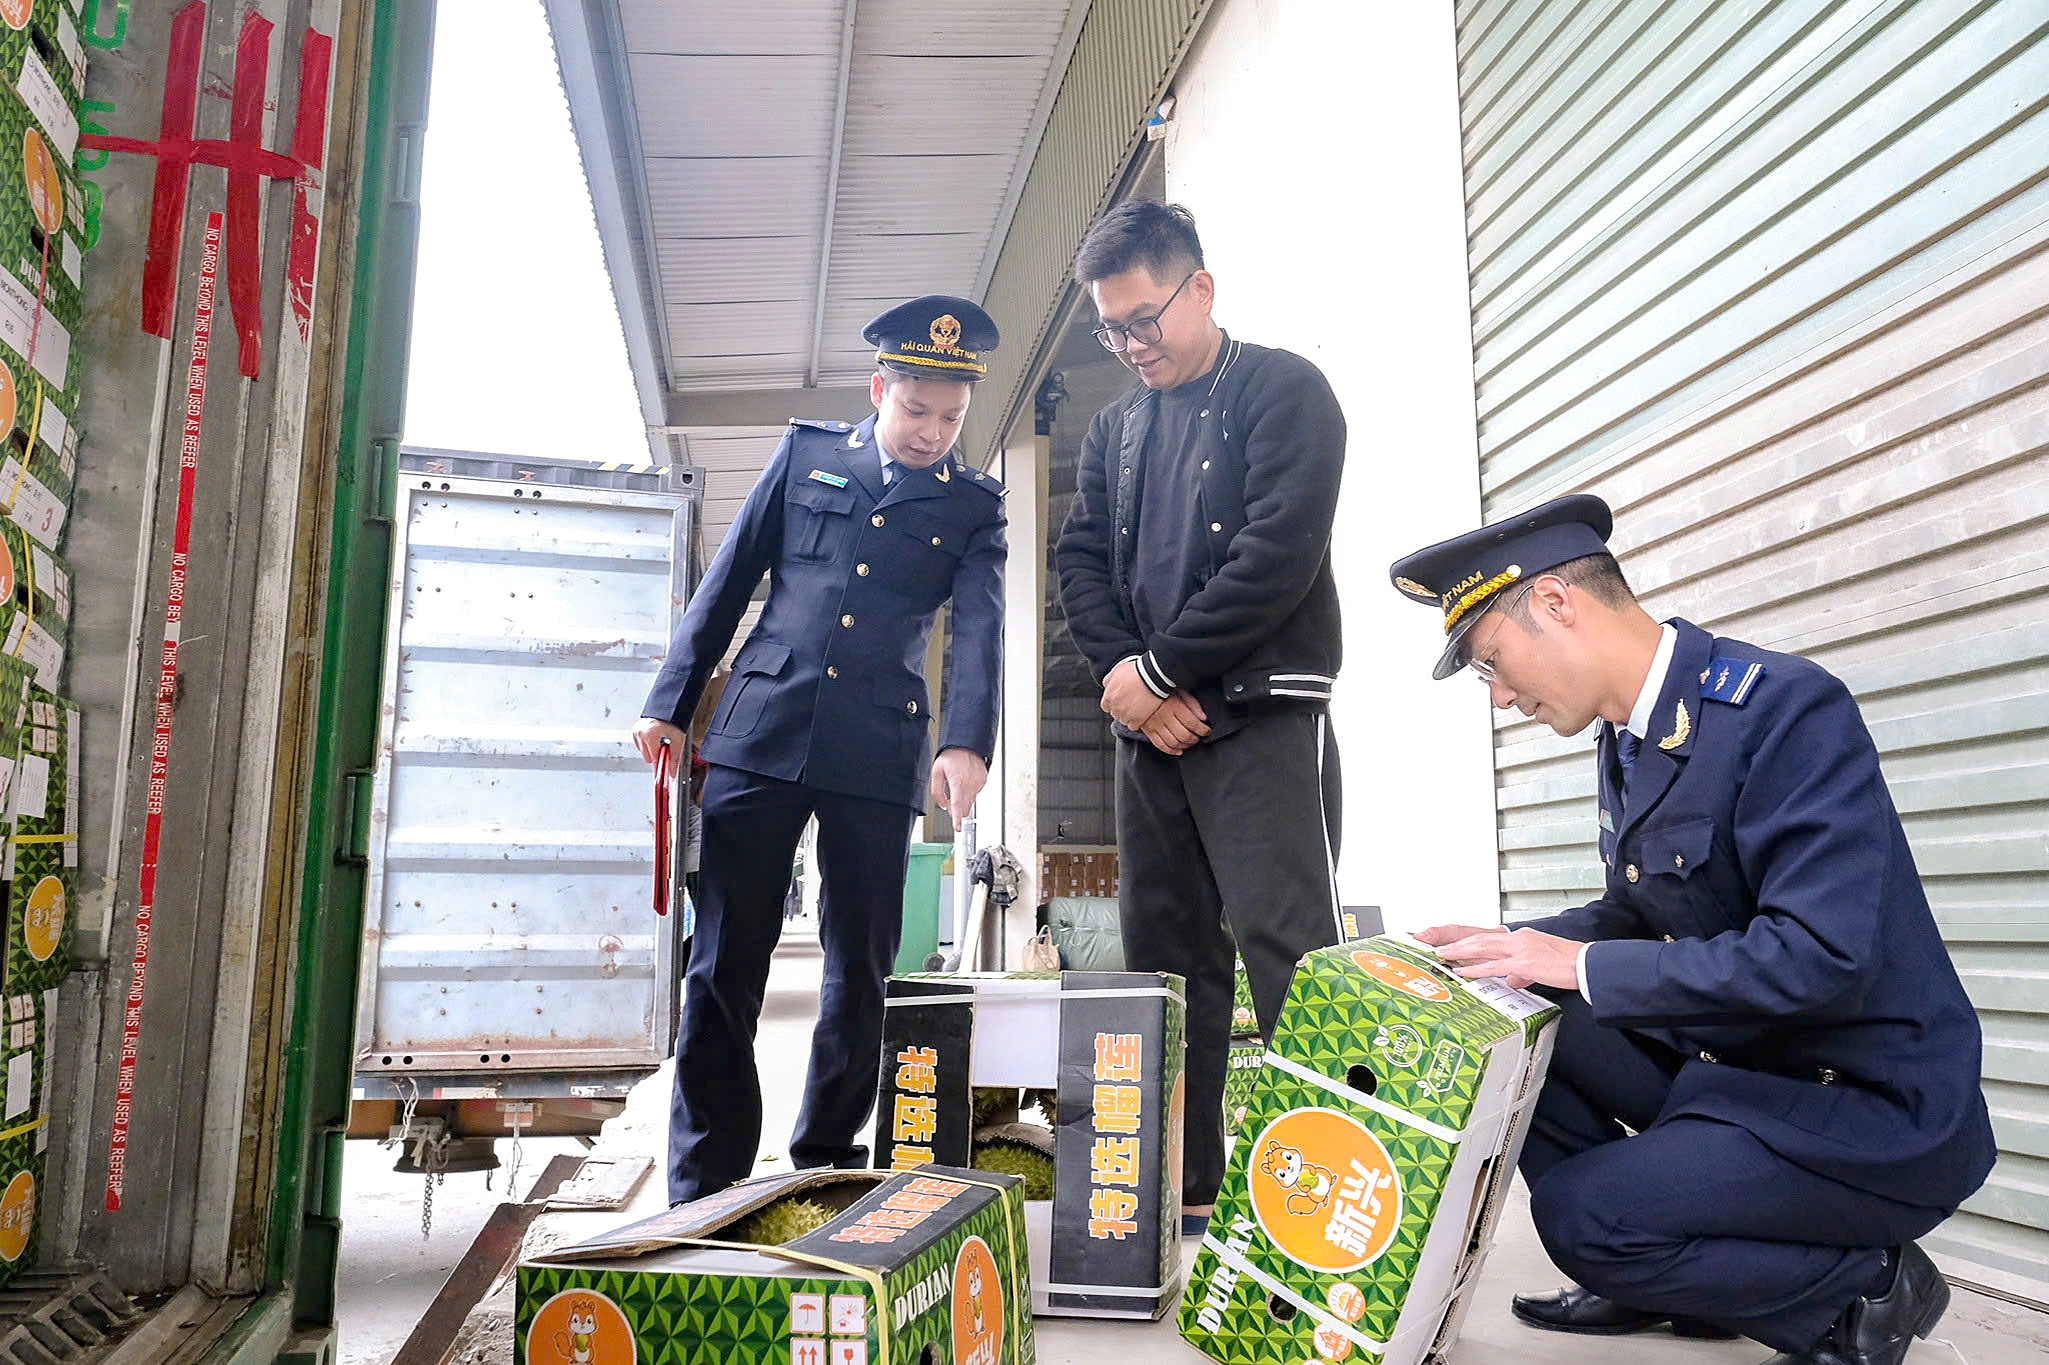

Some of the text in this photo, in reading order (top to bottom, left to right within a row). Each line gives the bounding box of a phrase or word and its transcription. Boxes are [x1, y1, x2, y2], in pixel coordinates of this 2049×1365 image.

[182, 228, 219, 468] NO CARGO BEYOND THIS LEVEL WHEN USED AS REEFER
[901, 341, 977, 360] HẢI QUAN VIỆT NAM
[173, 552, 186, 566] NO
[169, 570, 184, 601] CARGO
[1452, 571, 1483, 596] NAM
[163, 646, 177, 666] THIS
[157, 702, 171, 728] WHEN
[154, 733, 168, 757] USED
[152, 761, 165, 774] AS
[148, 778, 164, 814] REEFER
[137, 905, 151, 919] NO
[135, 924, 149, 958] CARGO
[129, 962, 146, 1001] BEYOND
[122, 1031, 138, 1061] LEVEL
[1392, 1033, 1408, 1056] 100%
[1434, 1046, 1452, 1080] PREMIUM
[119, 1065, 134, 1093] WHEN
[115, 1099, 129, 1124] USED
[113, 1128, 126, 1143] AS
[1088, 1033, 1143, 1241] 特选榴莲
[109, 1148, 125, 1189] REEFER
[1324, 1157, 1392, 1258] 新兴
[1196, 1212, 1256, 1336] DURAN
[895, 1262, 951, 1331] DURIAN
